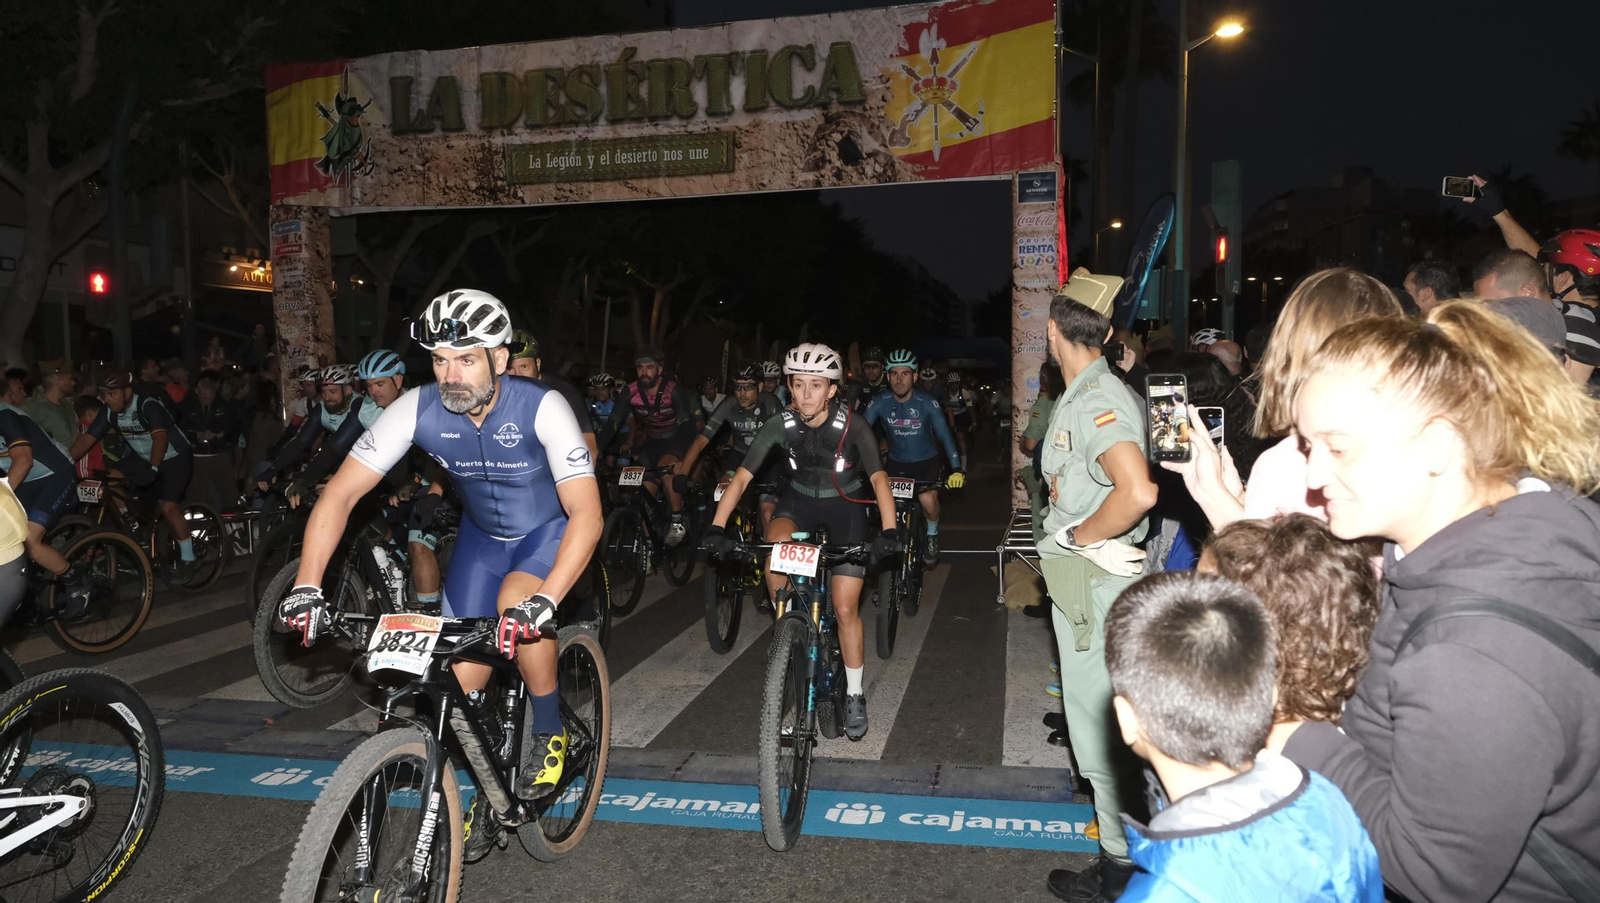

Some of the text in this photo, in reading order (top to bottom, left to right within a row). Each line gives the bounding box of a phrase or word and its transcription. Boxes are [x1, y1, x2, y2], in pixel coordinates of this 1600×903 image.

[389, 41, 867, 134] LA DESÉRTICA
[529, 148, 709, 171] La Legión y el desierto nos une
[1019, 245, 1055, 254] RENTA
[1019, 255, 1055, 266] TODO
[623, 472, 641, 480] 8837
[890, 482, 912, 491] 8404
[779, 543, 816, 564] 8632
[376, 630, 430, 657] 8824
[670, 809, 760, 821] CAJA RURAL
[898, 810, 1090, 834] cajamar
[411, 809, 438, 874] ROCKSHOX
[994, 830, 1094, 842] CAJA RURAL
[86, 842, 136, 903] SCORPION
